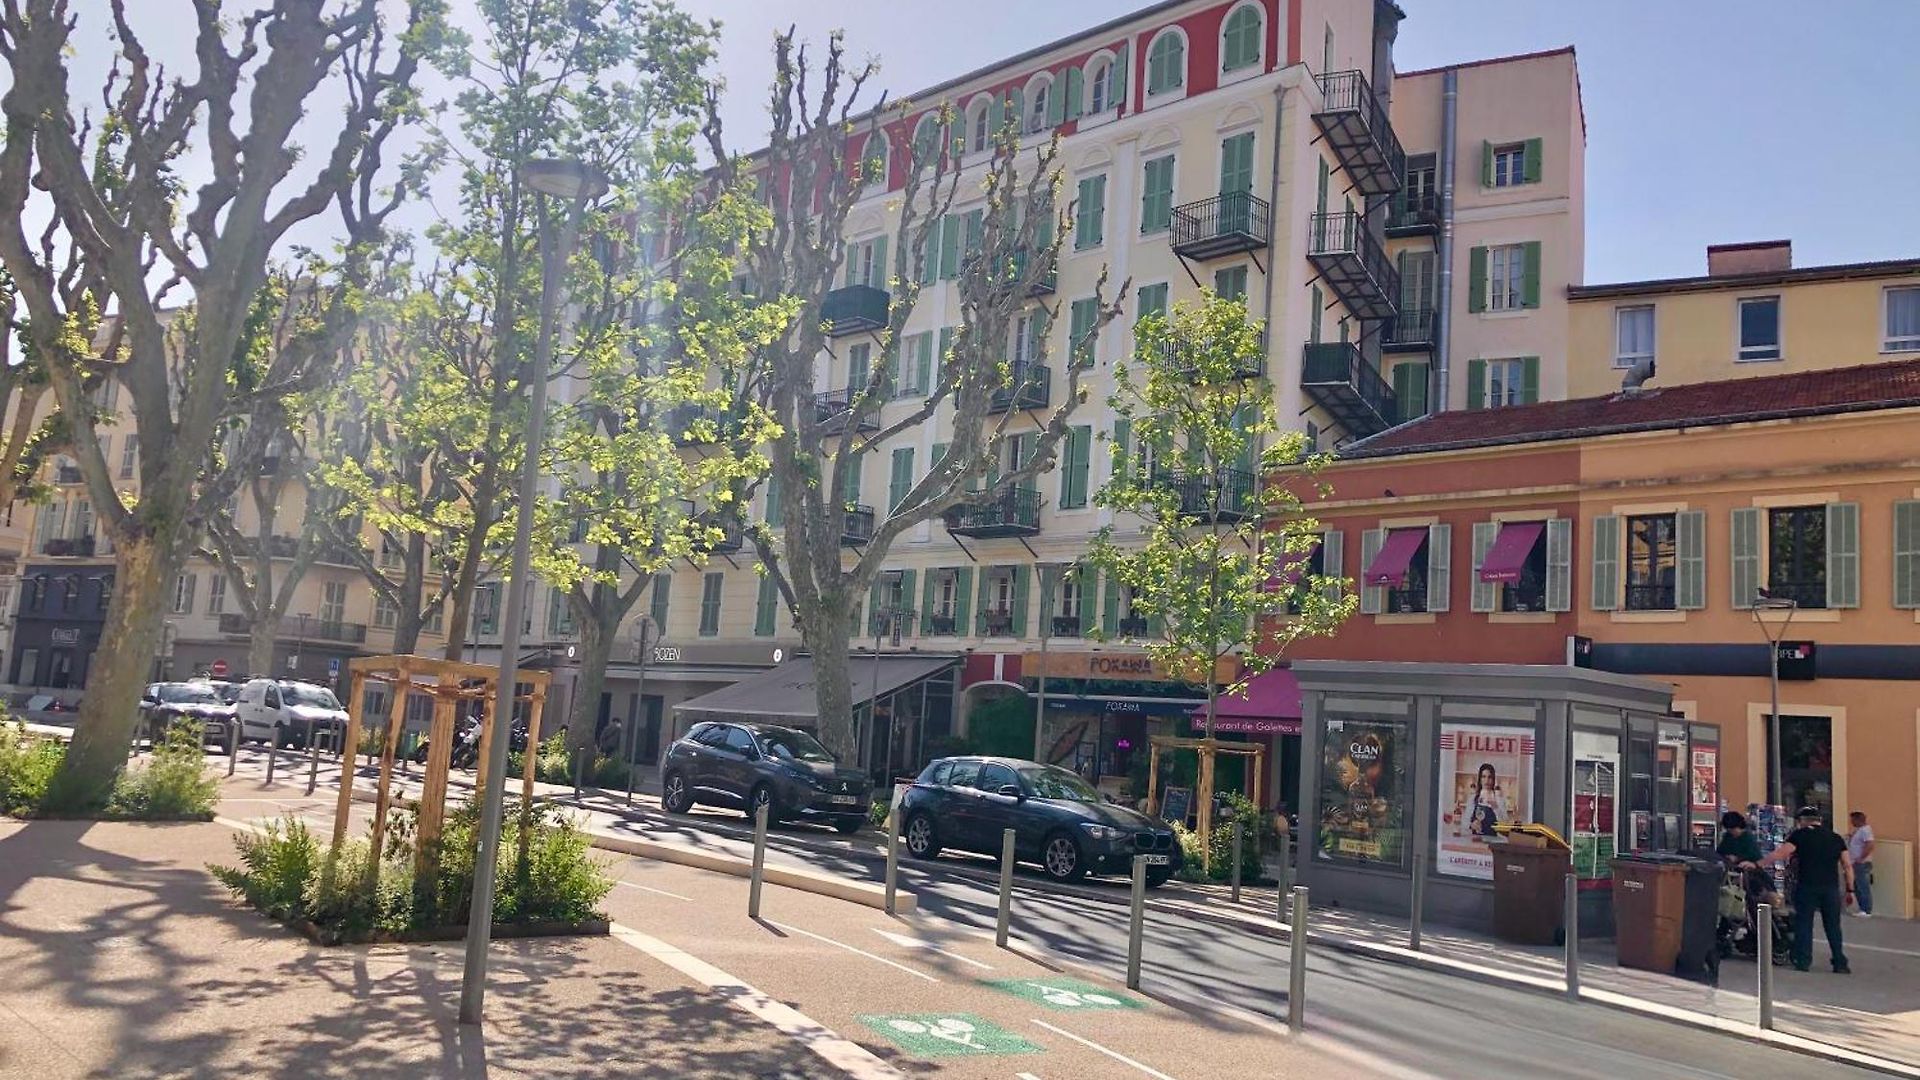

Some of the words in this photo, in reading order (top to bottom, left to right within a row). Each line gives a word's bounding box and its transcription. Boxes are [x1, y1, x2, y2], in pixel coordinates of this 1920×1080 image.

[1090, 657, 1152, 674] POKAWA
[1350, 742, 1379, 755] CLAN
[1457, 732, 1517, 753] LILLET
